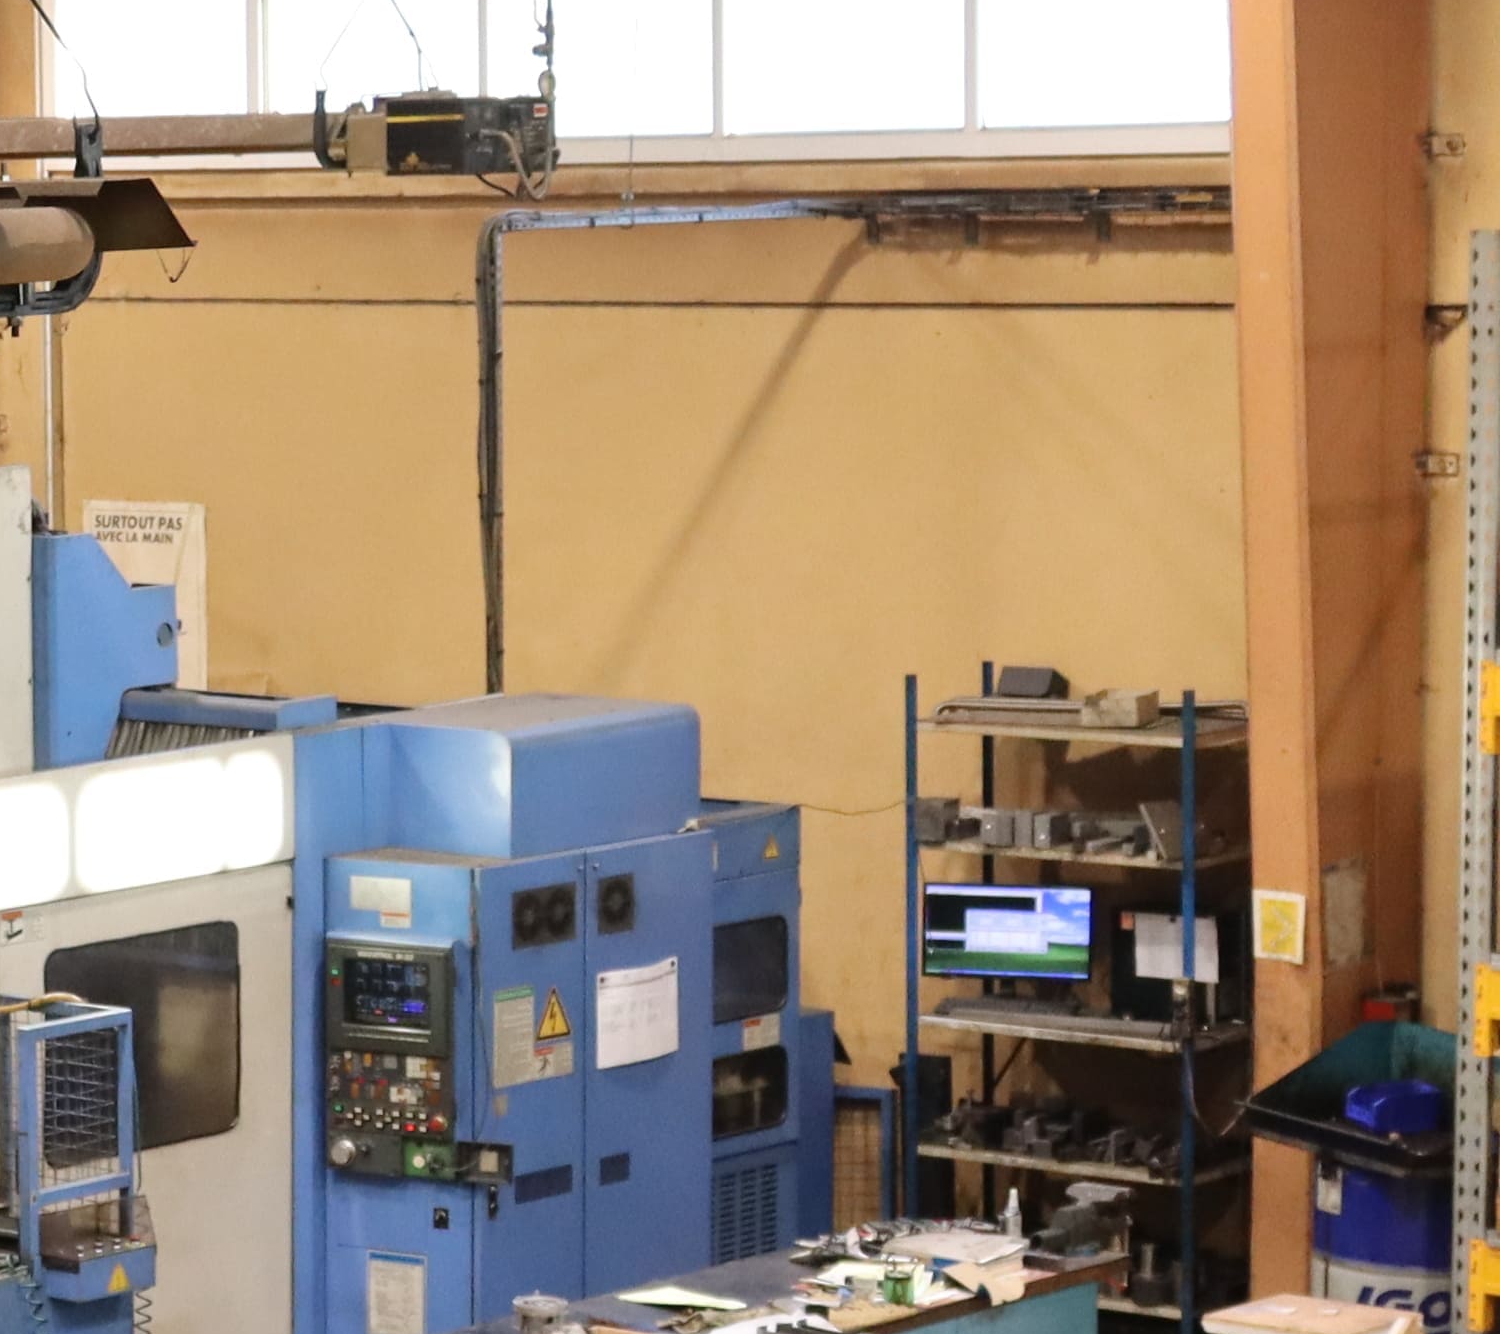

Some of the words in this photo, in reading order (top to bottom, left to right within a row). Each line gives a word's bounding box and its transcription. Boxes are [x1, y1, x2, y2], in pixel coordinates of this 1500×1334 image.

[94, 514, 156, 530] SURTOUT
[158, 516, 183, 530] PAS
[95, 531, 123, 543] AVEC
[125, 531, 139, 543] LA
[141, 532, 174, 545] MAIN
[1356, 1285, 1452, 1328] IGO
